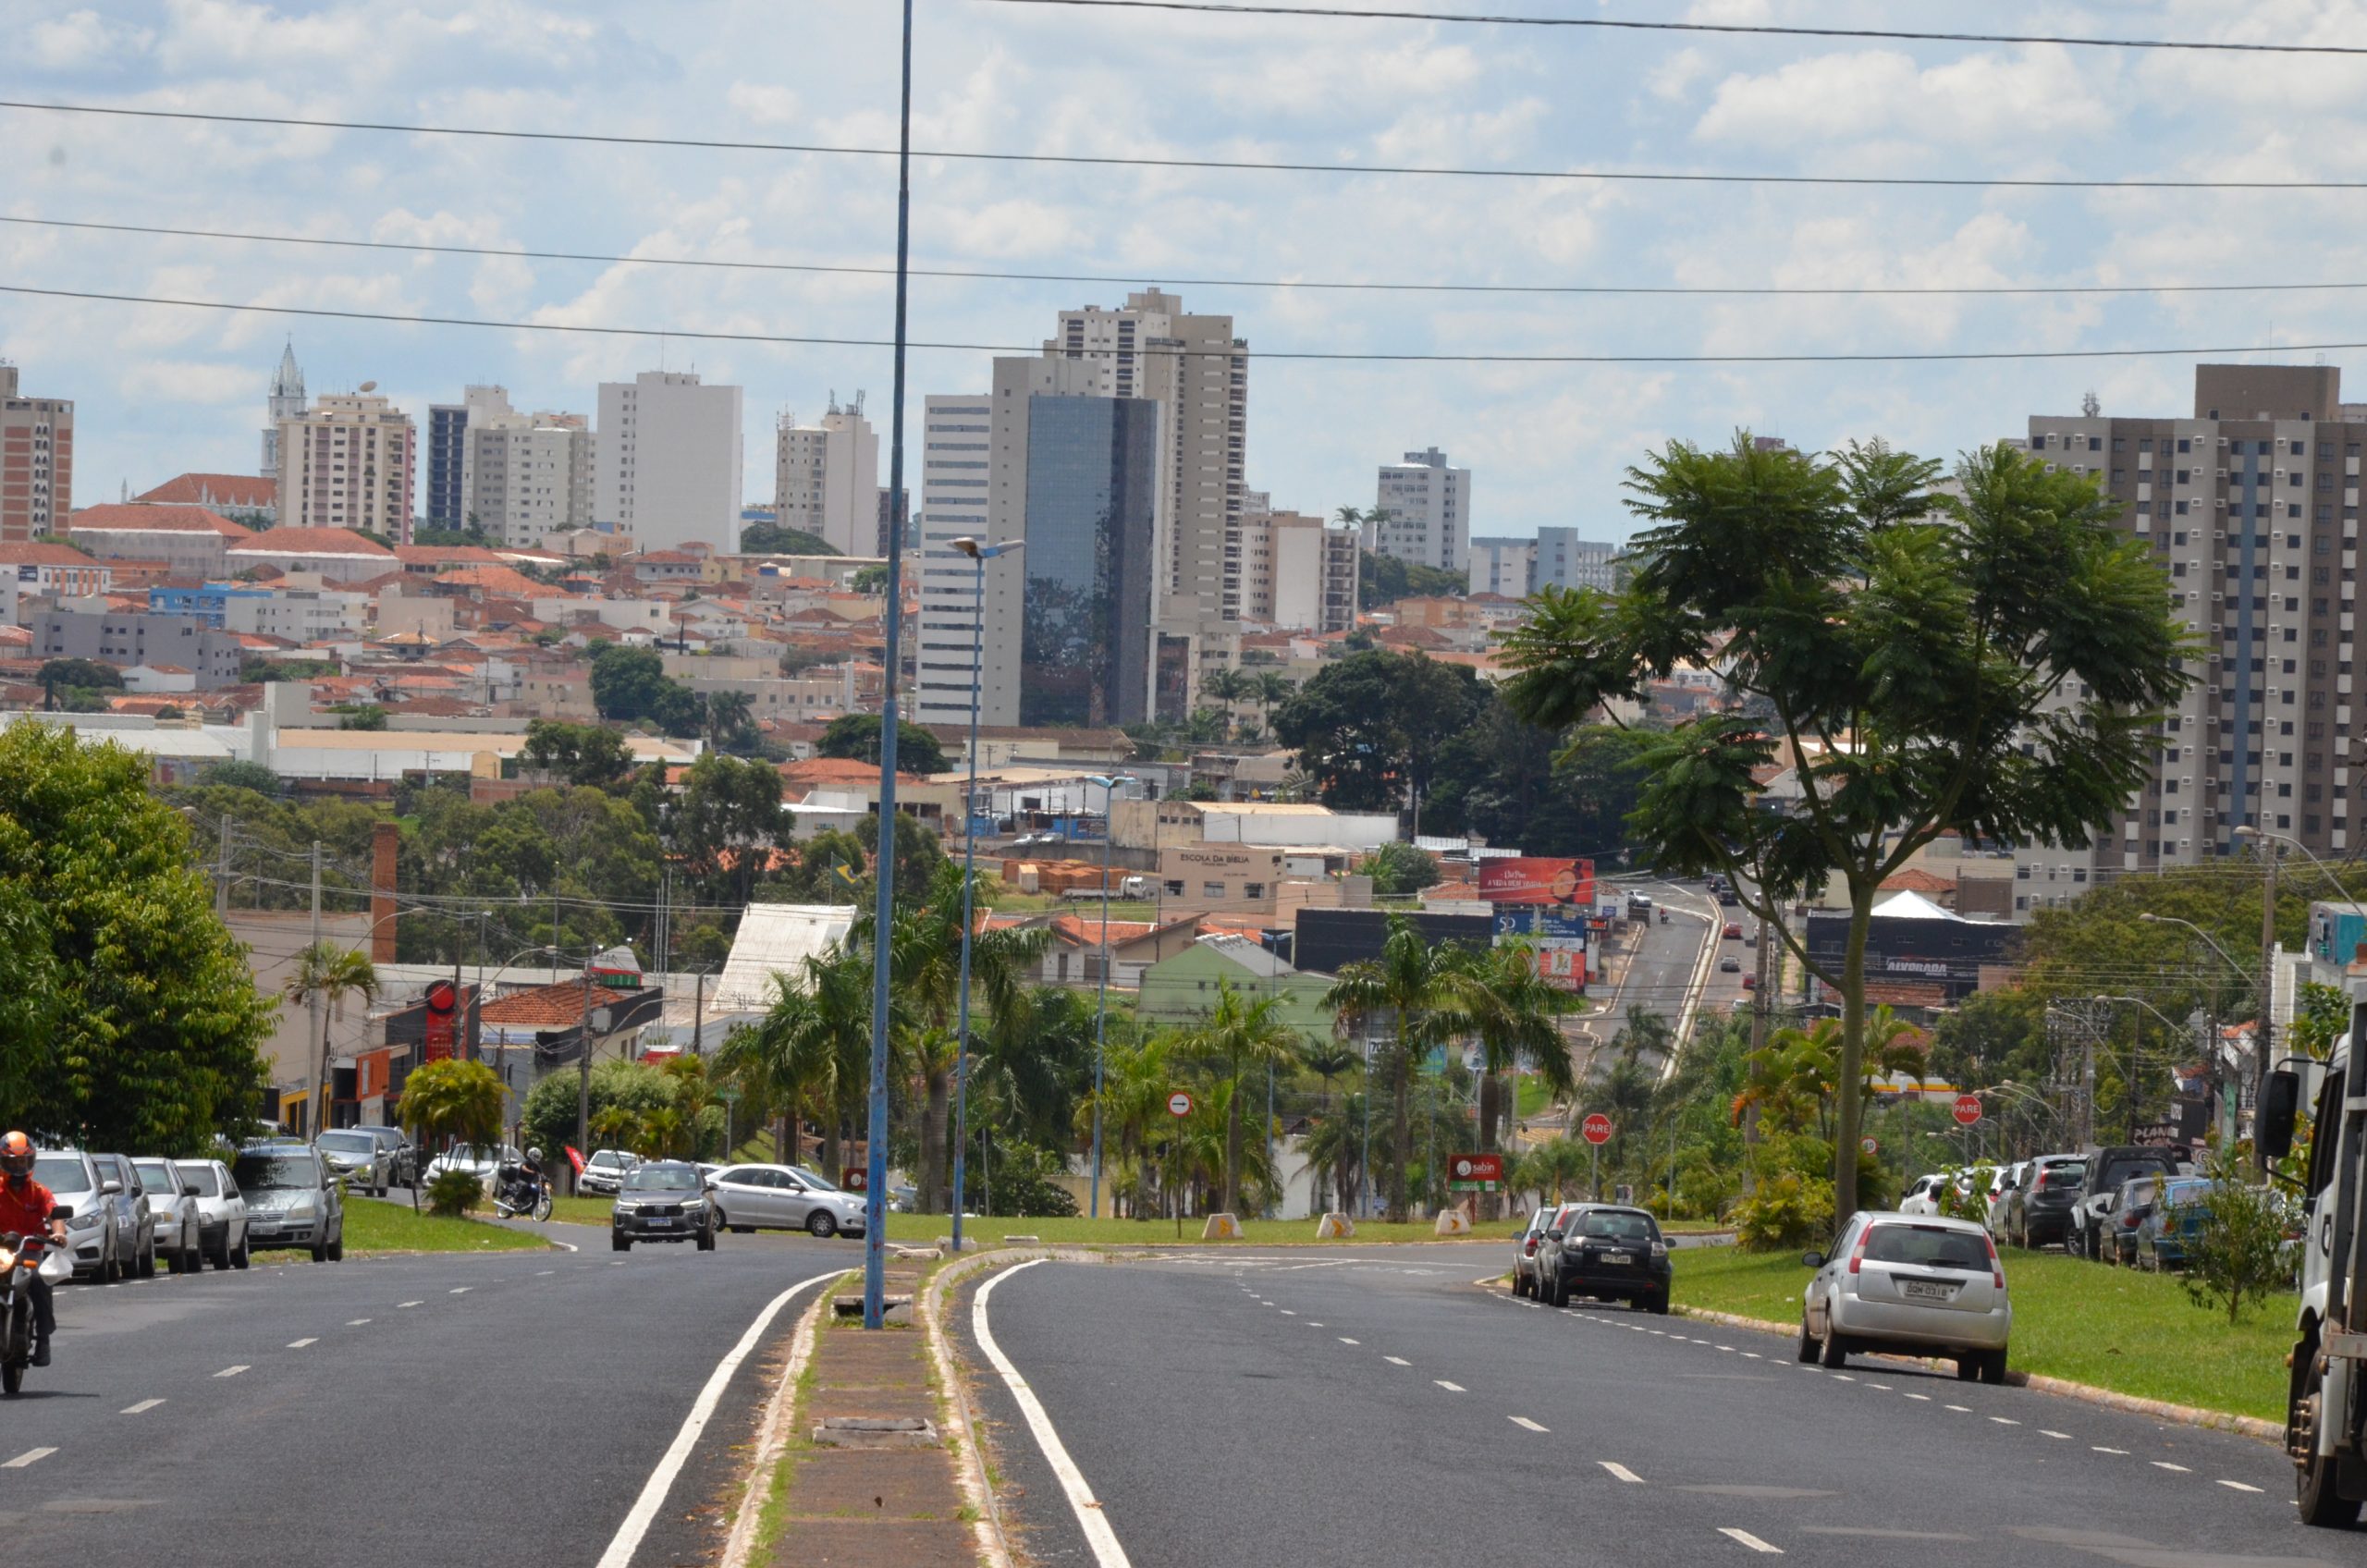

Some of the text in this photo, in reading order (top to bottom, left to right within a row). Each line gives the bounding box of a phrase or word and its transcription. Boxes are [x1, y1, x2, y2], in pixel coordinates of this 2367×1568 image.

[1180, 853, 1211, 862] ESCOLA
[1226, 853, 1250, 864] BÍBLIA
[1887, 962, 1946, 973] ALVORADA
[1955, 1105, 1979, 1113] PARE
[1585, 1123, 1609, 1133] PARE
[1472, 1161, 1495, 1171] sabin
